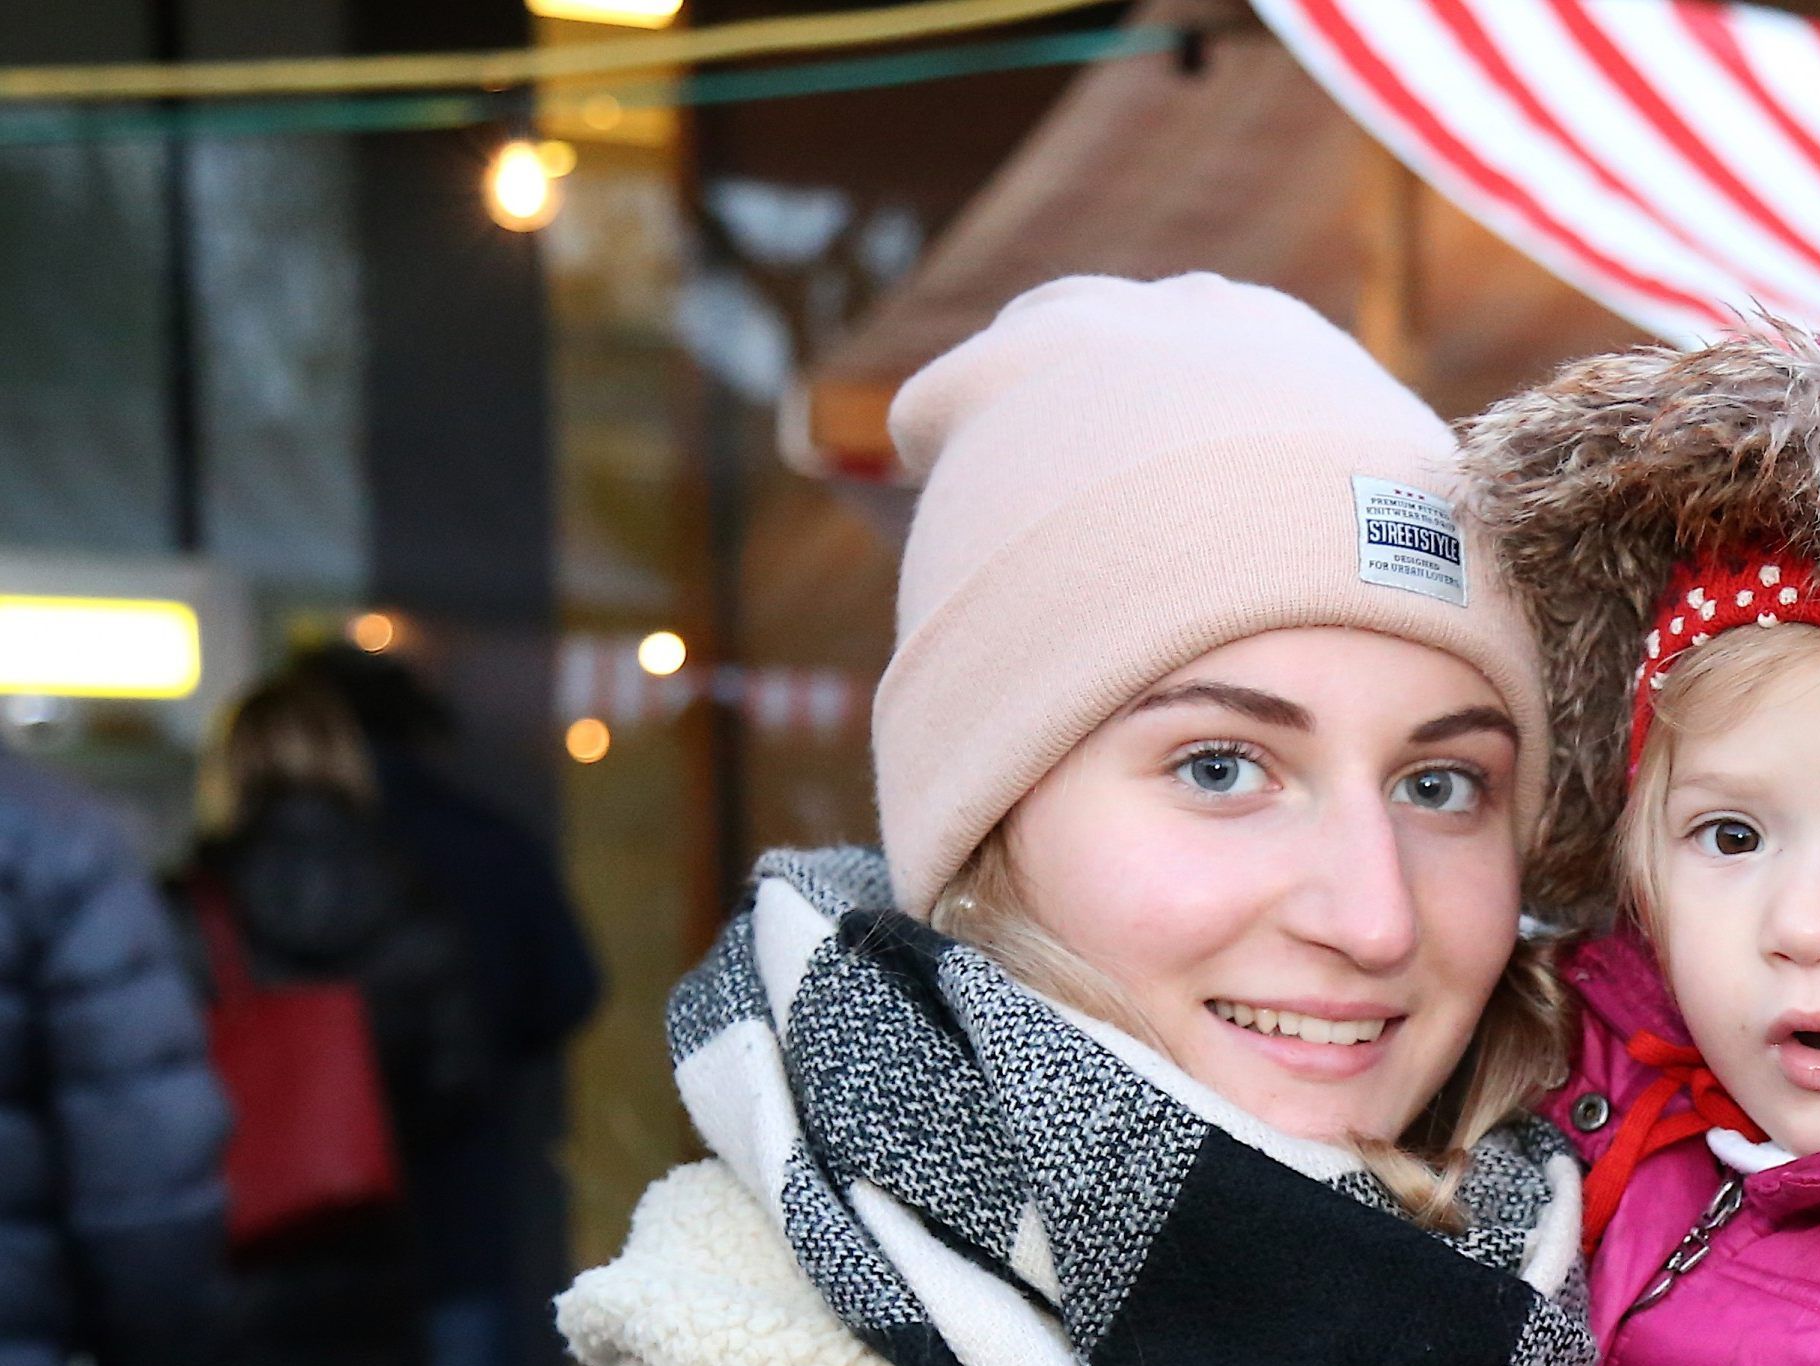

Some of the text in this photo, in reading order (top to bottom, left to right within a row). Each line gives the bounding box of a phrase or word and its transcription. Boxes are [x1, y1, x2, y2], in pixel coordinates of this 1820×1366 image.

[1369, 521, 1458, 561] STREETSTYLE
[1369, 560, 1389, 571] FOR
[1391, 563, 1425, 577] URBAN
[1394, 554, 1440, 571] DESIGNED
